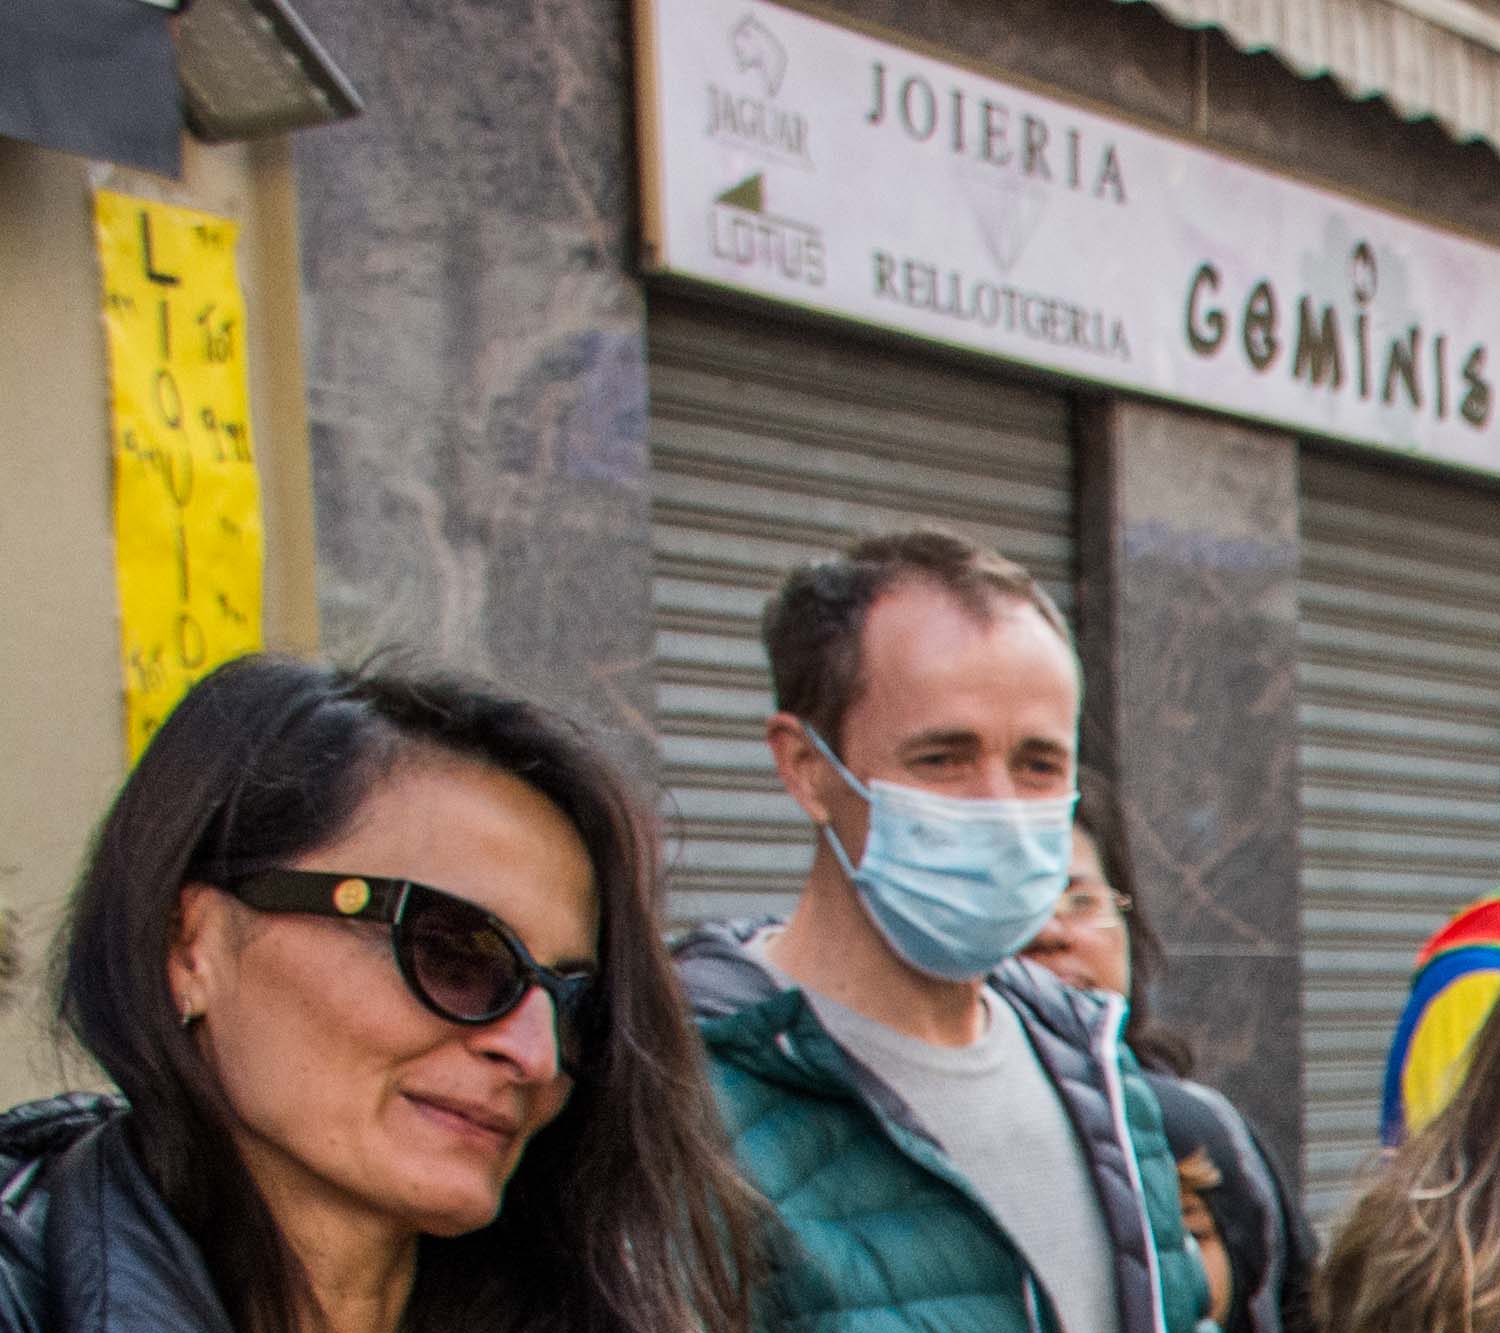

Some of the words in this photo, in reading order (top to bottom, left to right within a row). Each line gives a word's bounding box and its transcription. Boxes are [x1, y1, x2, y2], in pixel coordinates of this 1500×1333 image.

[703, 83, 812, 163] JAGUAR
[866, 60, 1128, 205] JOIERIA
[710, 208, 826, 287] LOTUS
[871, 249, 1133, 363] RELLOTGERIA
